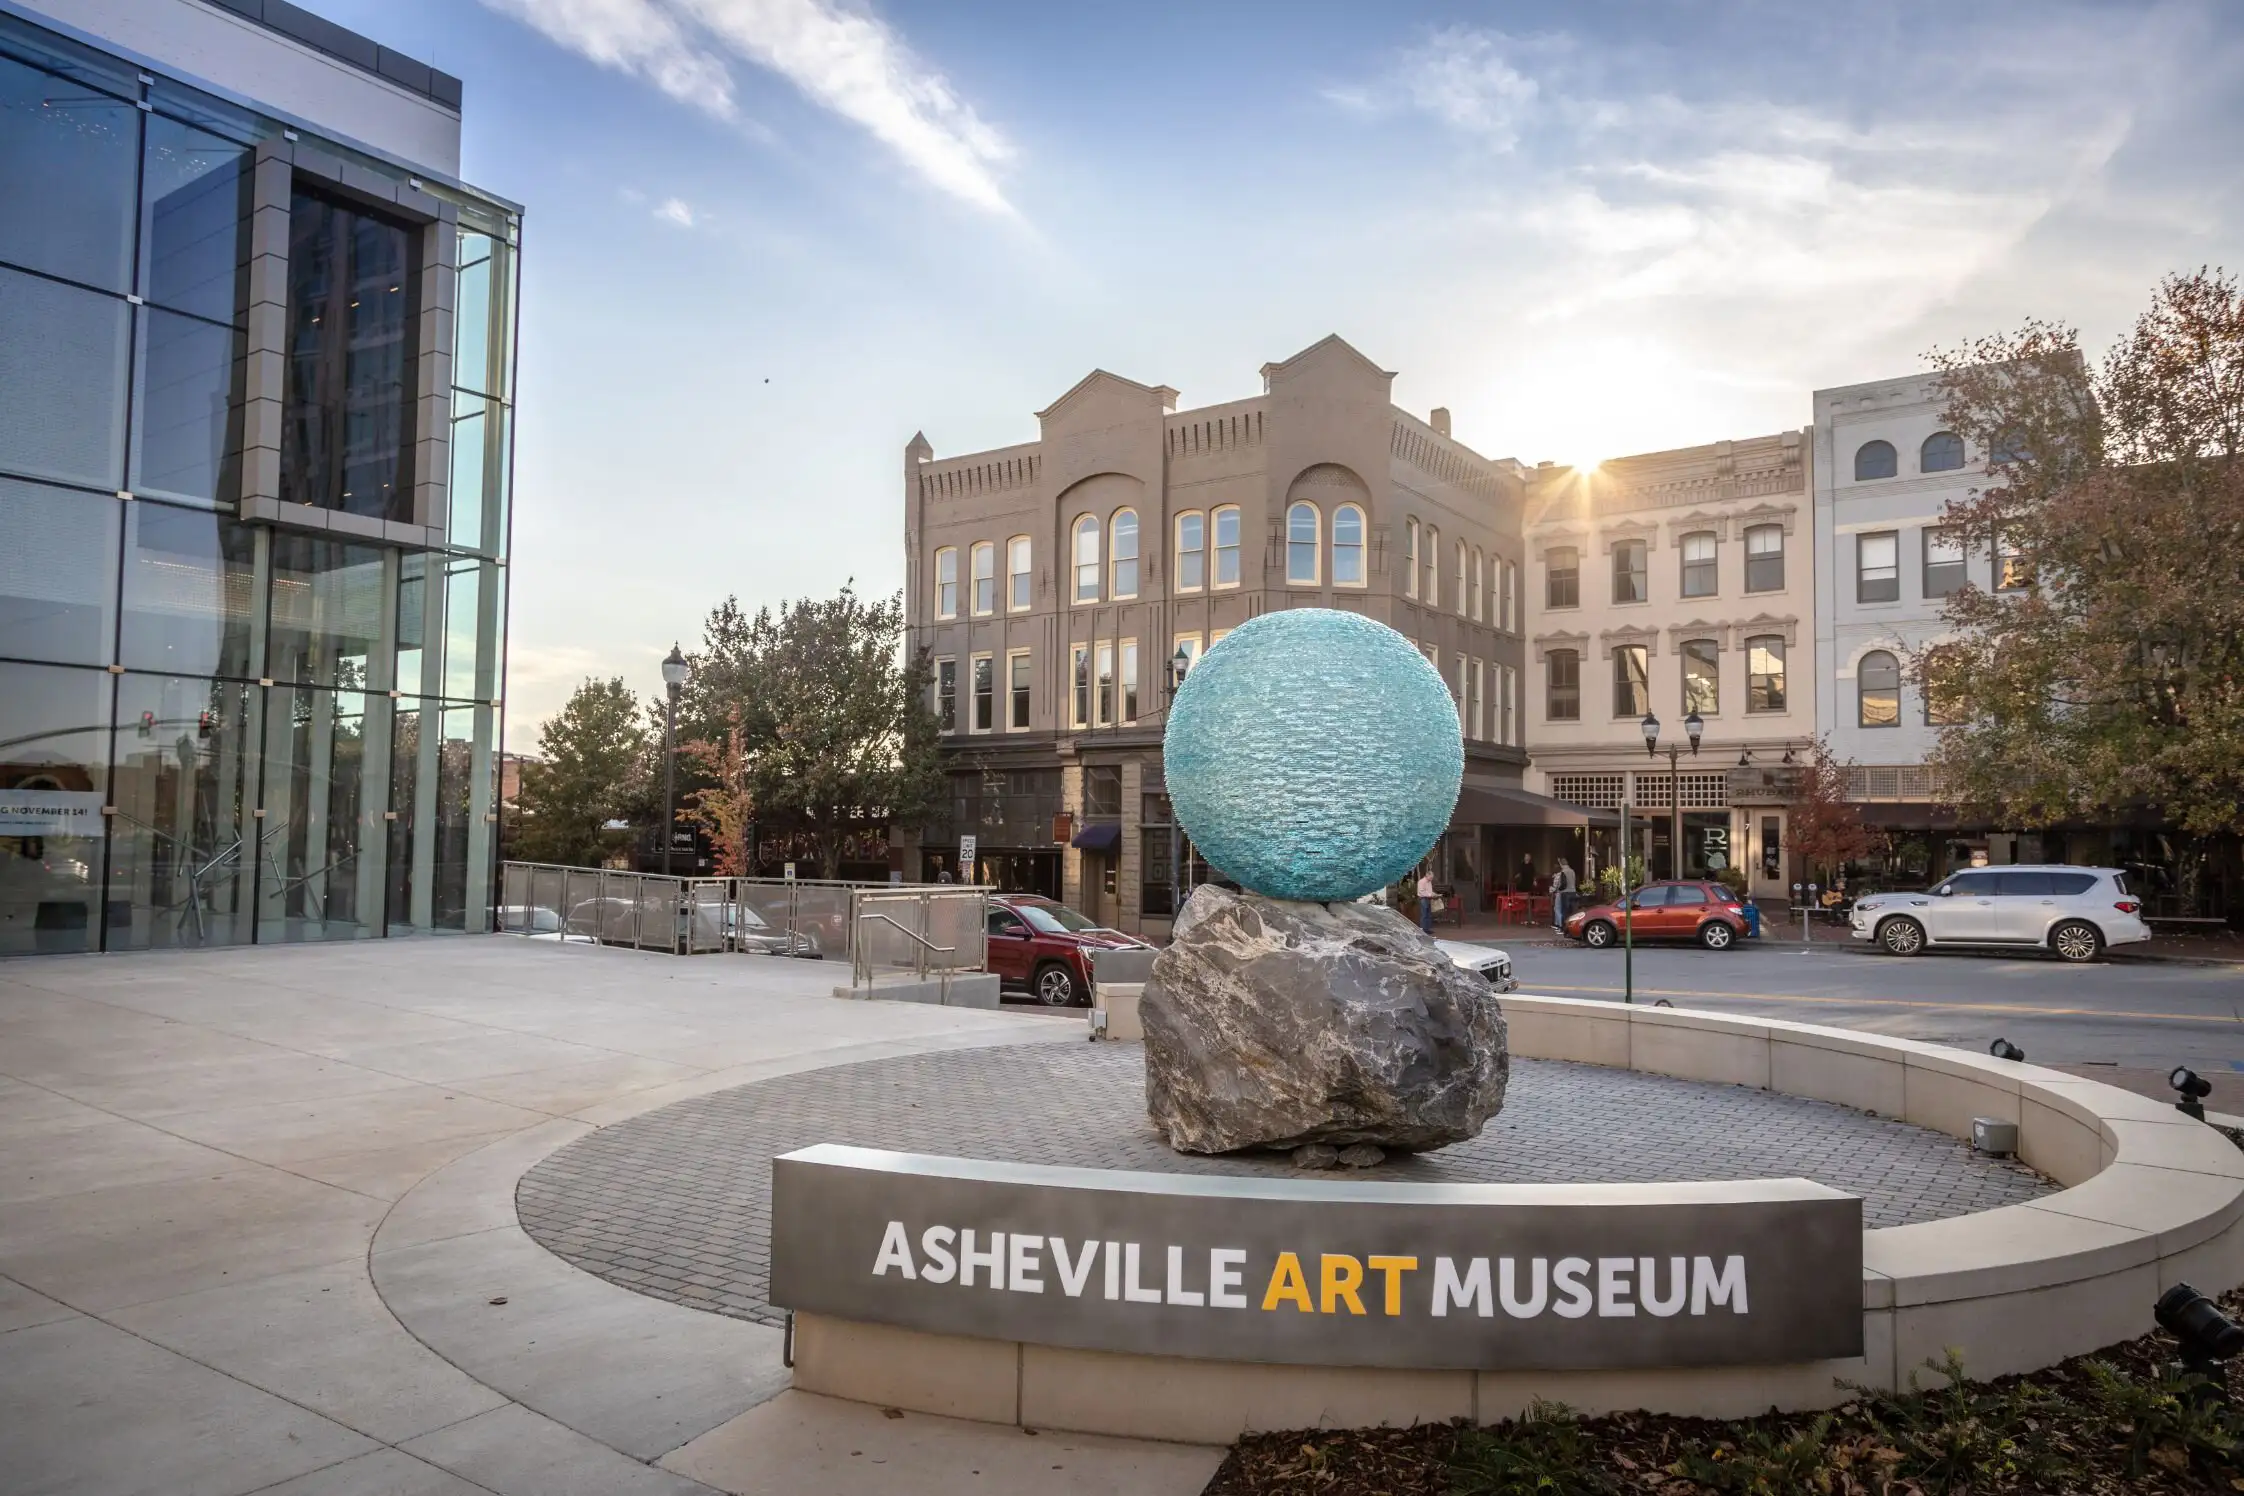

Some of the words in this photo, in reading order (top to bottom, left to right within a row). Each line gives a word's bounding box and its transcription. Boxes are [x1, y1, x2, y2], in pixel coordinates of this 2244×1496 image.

[1735, 788, 1806, 798] RHUBA
[11, 807, 70, 816] NOVEMBER
[71, 808, 88, 816] 14!
[1703, 827, 1728, 845] R
[961, 848, 974, 859] 20
[872, 1221, 1247, 1308] ASHEVILLE
[1261, 1251, 1418, 1316] ART
[1431, 1255, 1748, 1319] MUSEUM
